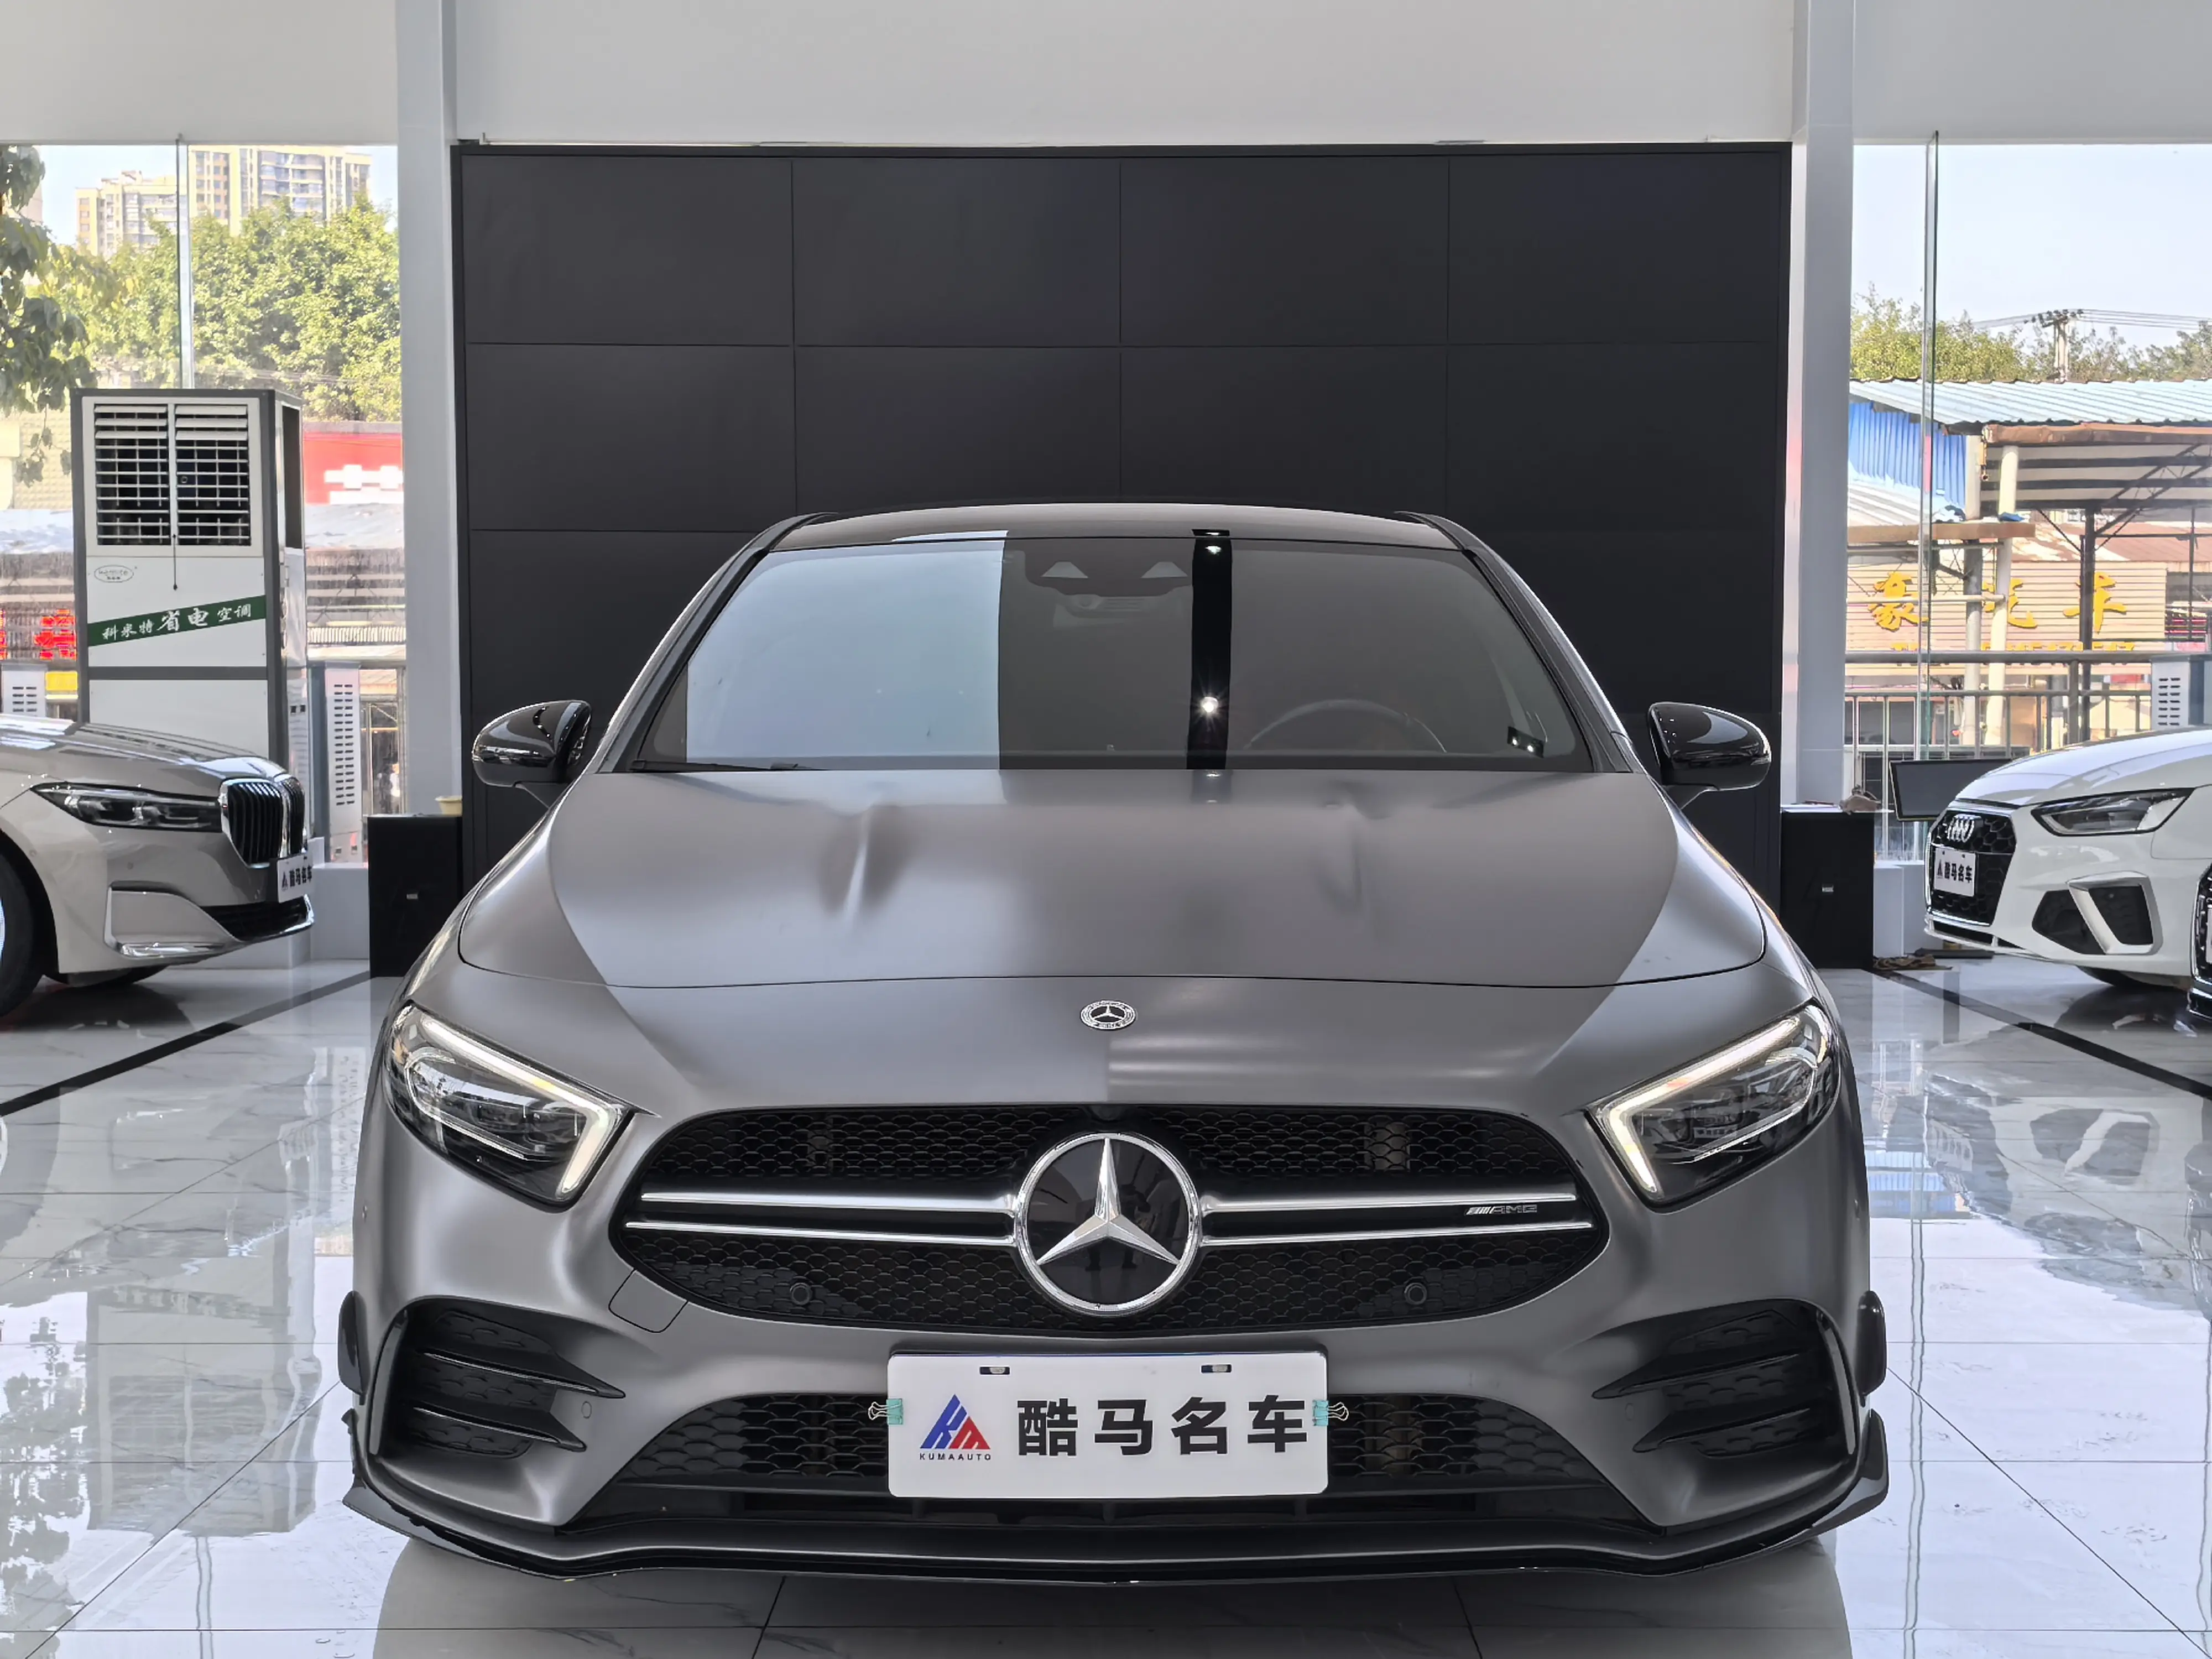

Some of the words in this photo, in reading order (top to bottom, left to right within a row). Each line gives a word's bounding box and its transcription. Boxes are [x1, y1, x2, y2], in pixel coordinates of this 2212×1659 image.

[1489, 1204, 1537, 1214] AMG
[1017, 1395, 1307, 1456] 酷马名车
